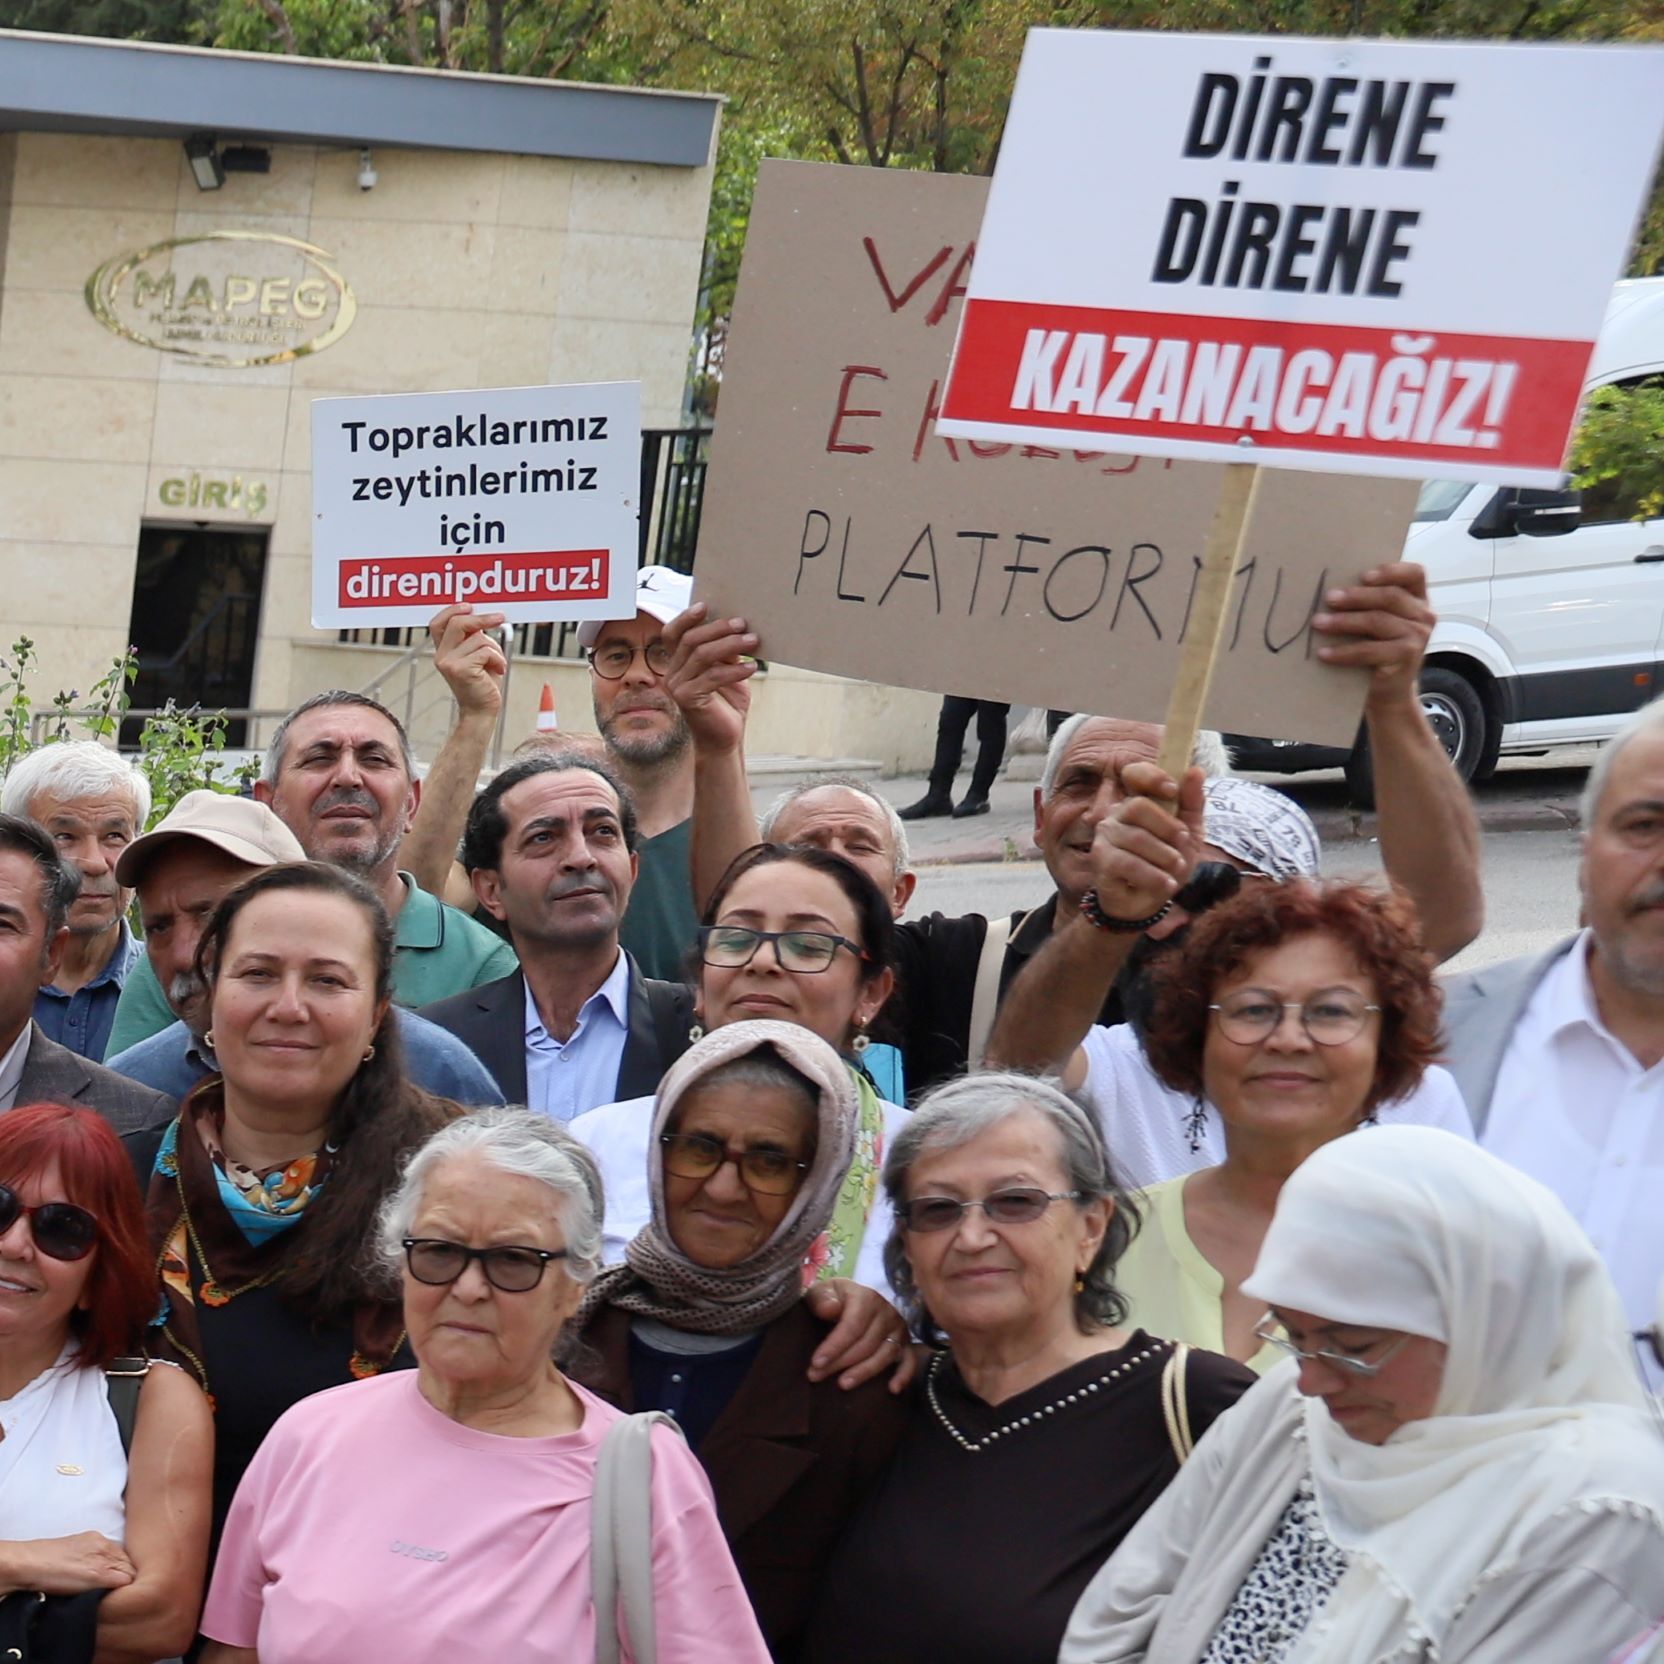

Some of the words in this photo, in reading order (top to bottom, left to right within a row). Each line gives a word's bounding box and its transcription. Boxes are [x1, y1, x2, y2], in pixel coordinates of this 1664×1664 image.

[1180, 56, 1456, 170] DİRENE
[1149, 181, 1422, 299] DİRENE
[133, 269, 327, 319] MAPEG
[1010, 328, 1518, 450] KAZANACAĞIZ!
[341, 414, 608, 457] Topraklarımız
[159, 472, 267, 518] GİRİŞ
[351, 460, 598, 506] zeytinlerimiz
[439, 513, 506, 554] için
[346, 558, 601, 603] direnipduruz!
